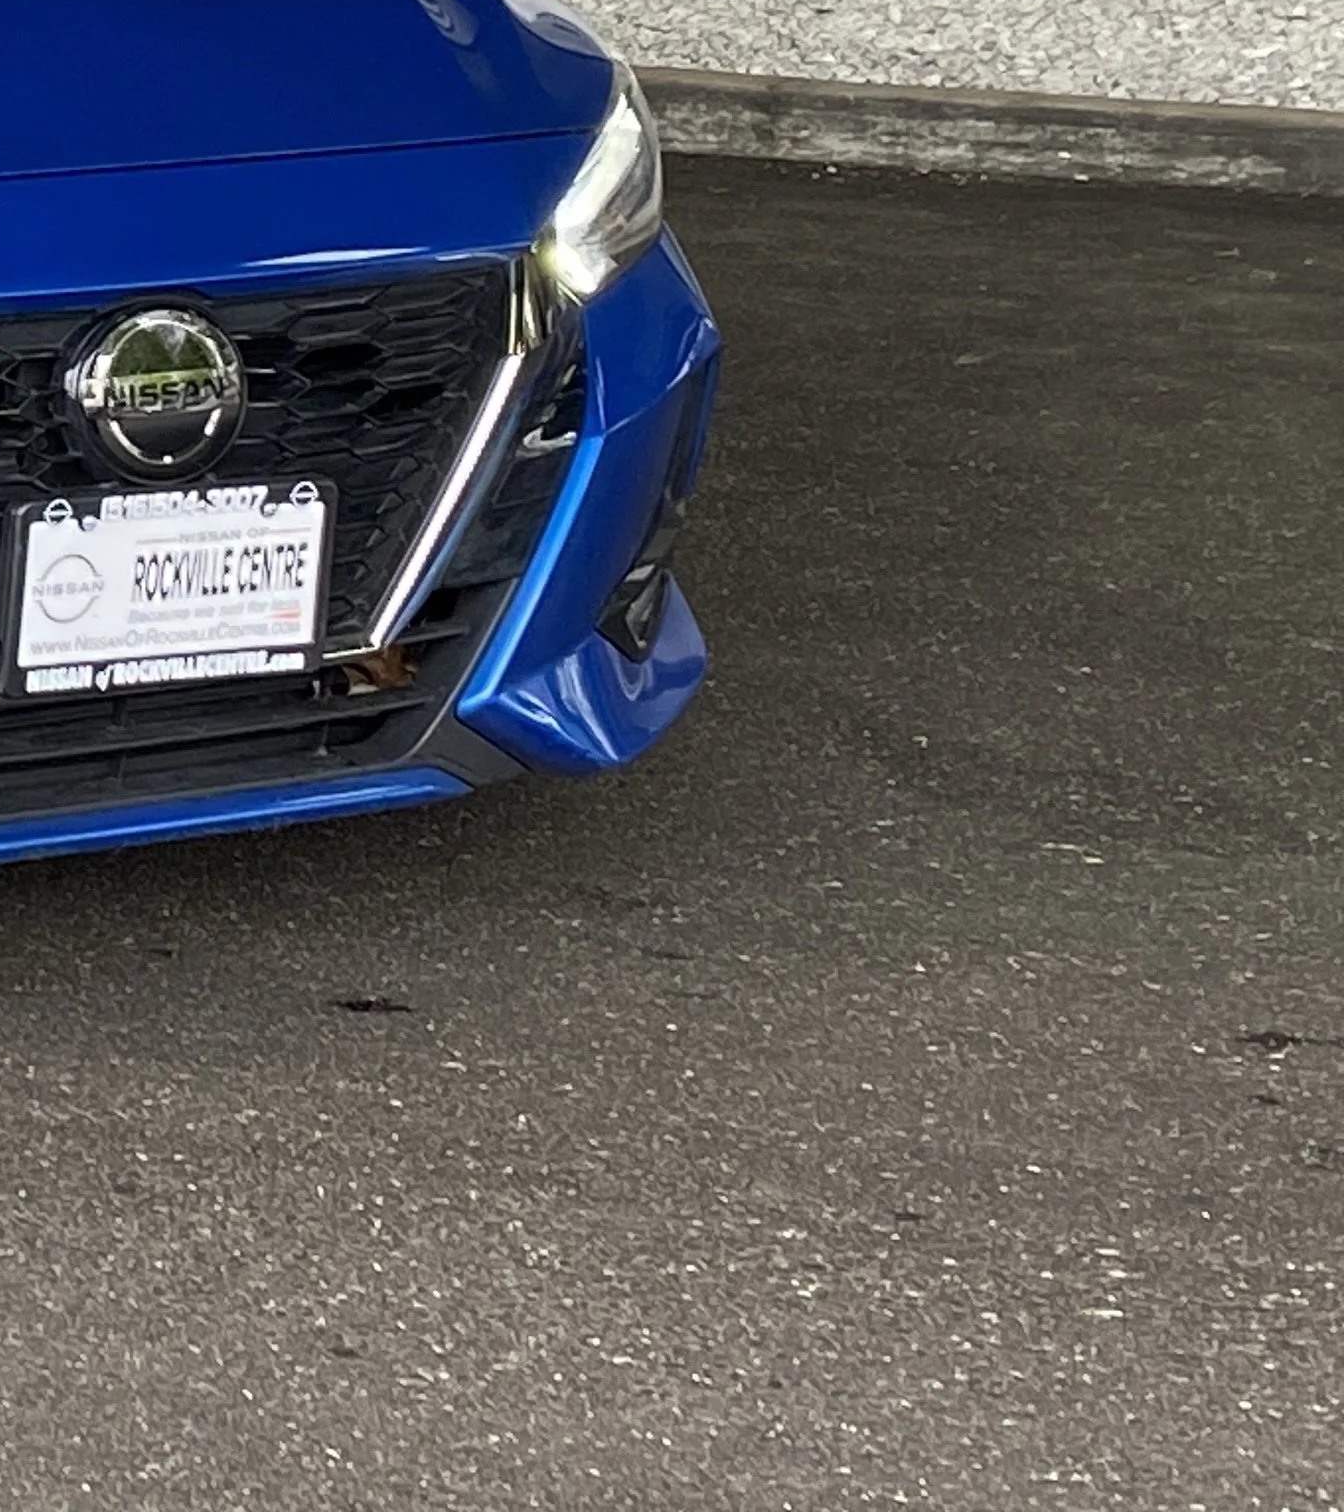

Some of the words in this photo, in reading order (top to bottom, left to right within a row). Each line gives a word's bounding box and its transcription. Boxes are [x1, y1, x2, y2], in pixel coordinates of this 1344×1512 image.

[105, 376, 223, 410] NISSAN
[32, 580, 105, 597] NISSAN
[131, 546, 233, 602] ROCKVILLE
[238, 541, 308, 594] CENTRE
